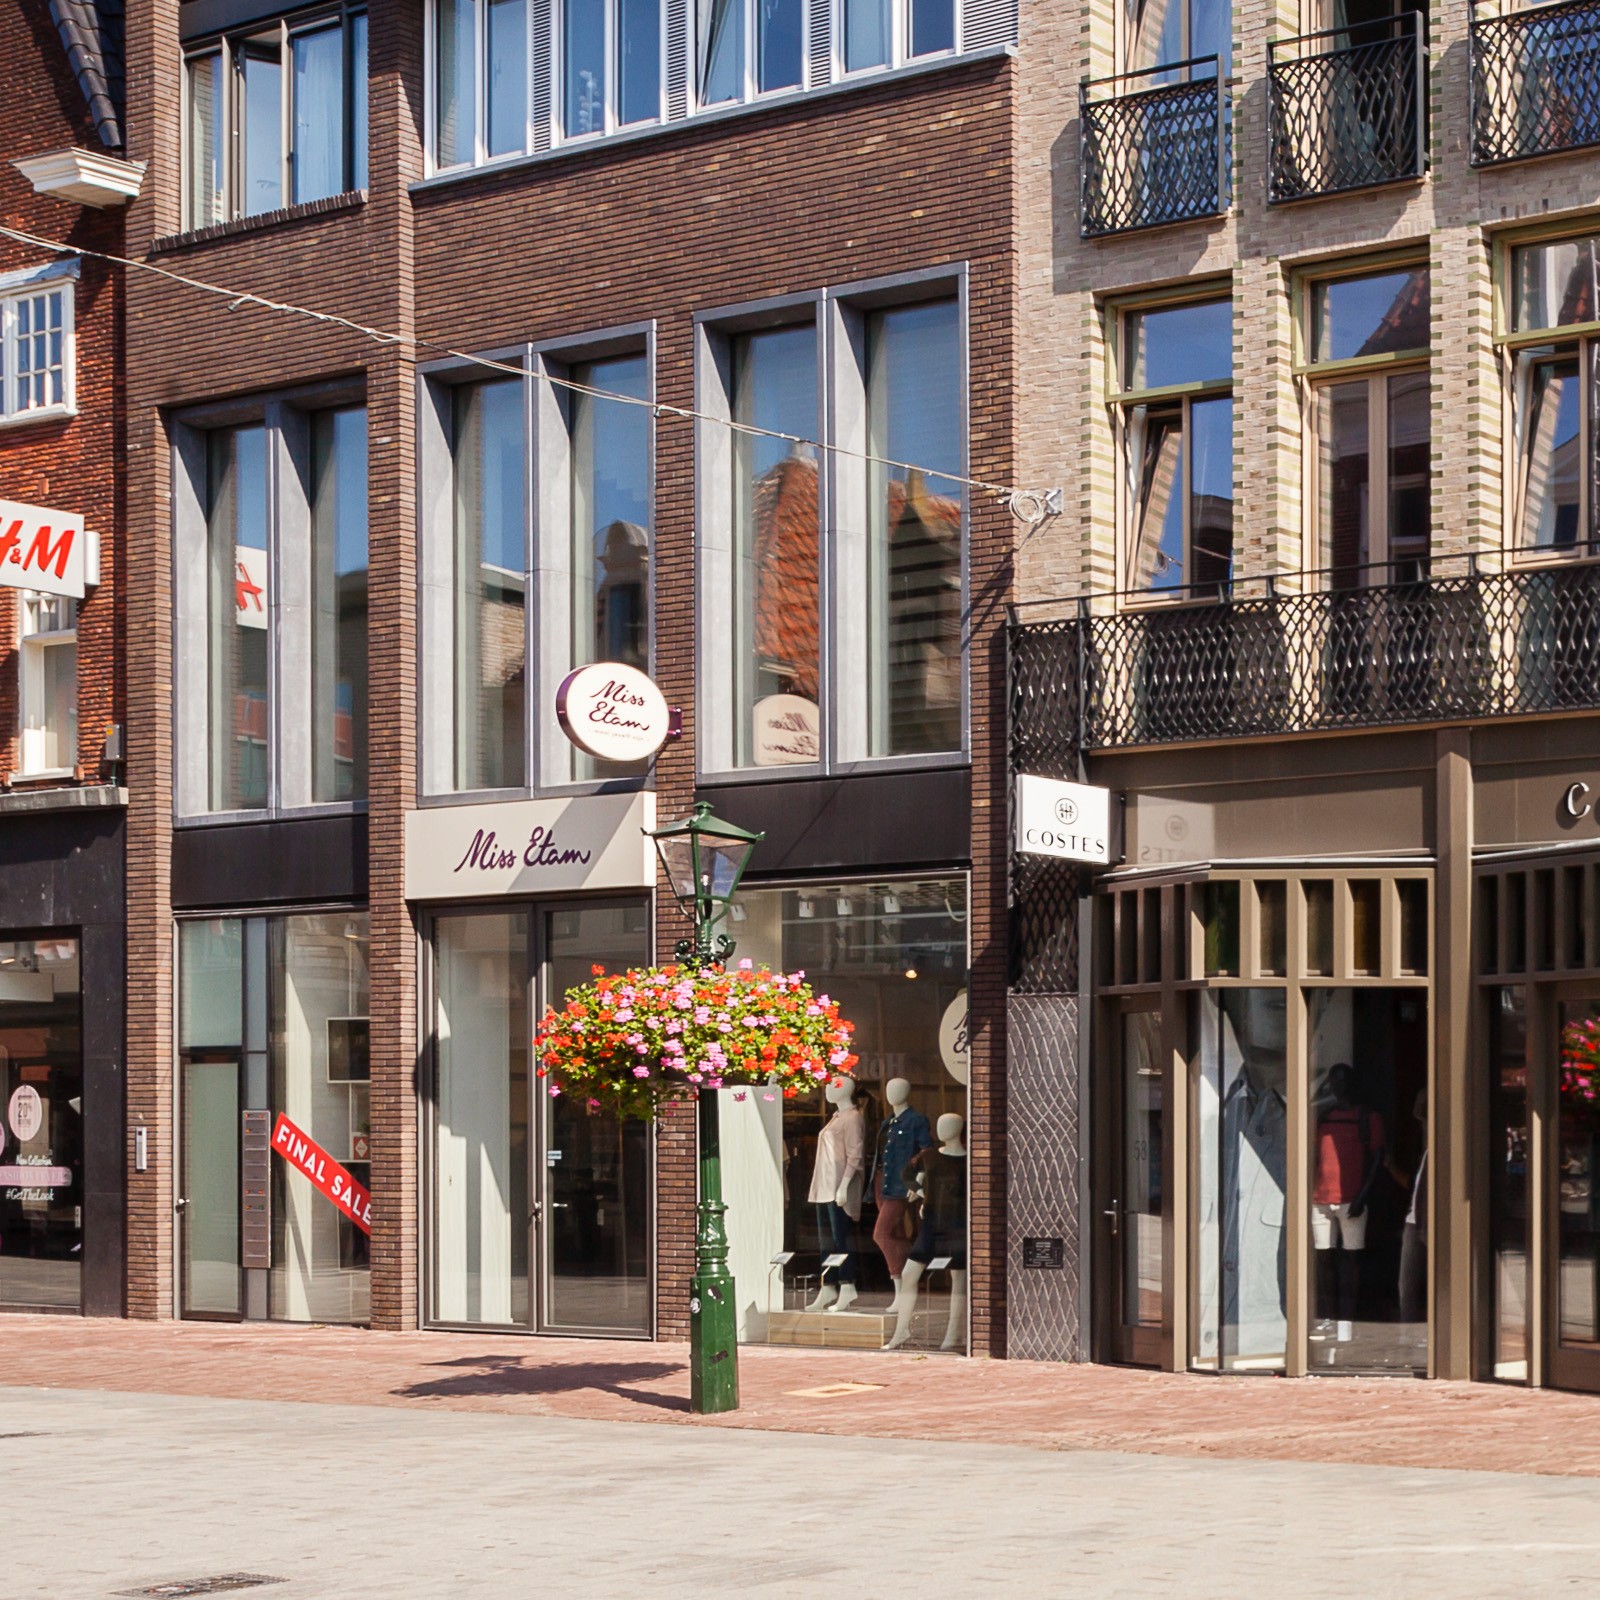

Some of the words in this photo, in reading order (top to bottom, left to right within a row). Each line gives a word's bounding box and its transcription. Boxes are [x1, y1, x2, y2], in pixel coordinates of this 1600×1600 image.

[590, 681, 645, 706] Miss
[589, 701, 649, 731] Etam
[454, 829, 517, 873] Miss
[523, 826, 591, 867] Etam
[1026, 828, 1105, 855] COSTES
[277, 1124, 325, 1183] FINAL
[331, 1175, 371, 1226] SALE
